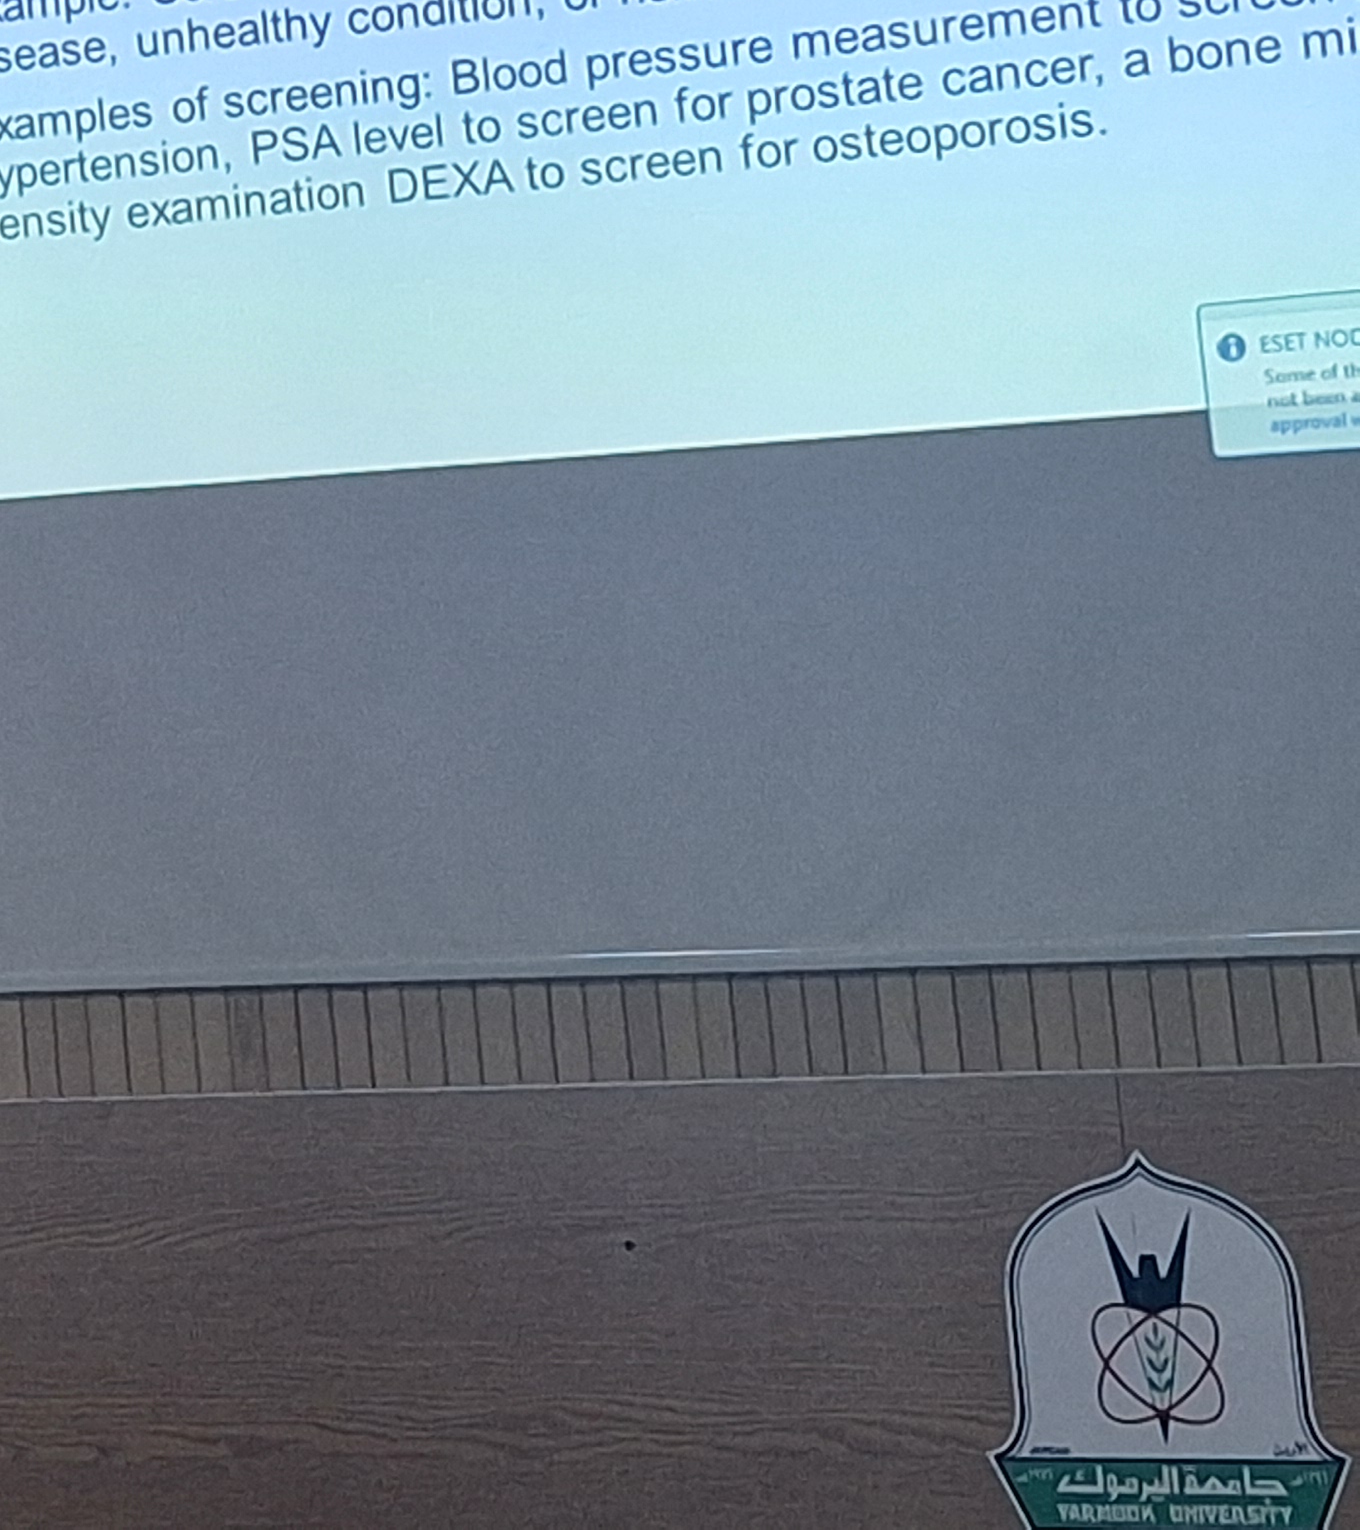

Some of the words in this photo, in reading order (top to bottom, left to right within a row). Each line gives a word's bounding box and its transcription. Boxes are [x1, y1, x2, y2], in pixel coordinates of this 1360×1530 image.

[134, 4, 334, 60] unhealthy
[171, 83, 211, 126] of
[222, 67, 434, 120] screening:
[450, 46, 570, 97] Blood
[584, 34, 775, 93] pressure
[249, 121, 345, 168] PSA
[351, 109, 446, 158] level
[460, 108, 503, 147] to
[515, 98, 659, 141] screen
[672, 84, 735, 126] for
[745, 64, 925, 128] prostate
[940, 52, 1105, 98] cancer,
[1122, 47, 1153, 79] a
[1166, 33, 1283, 75] bone
[125, 174, 367, 231] examination
[386, 156, 517, 206] DEXA
[523, 155, 567, 193] to
[578, 145, 725, 188] screen
[737, 130, 801, 172] for
[811, 100, 1109, 165] osteoporosis.
[1259, 331, 1307, 354] ESET
[1055, 1463, 1180, 1502] اليرموك
[1182, 1463, 1290, 1505] جامعة
[1056, 1502, 1158, 1524] YARMOUK
[1168, 1503, 1294, 1526] UNIVERSITY
